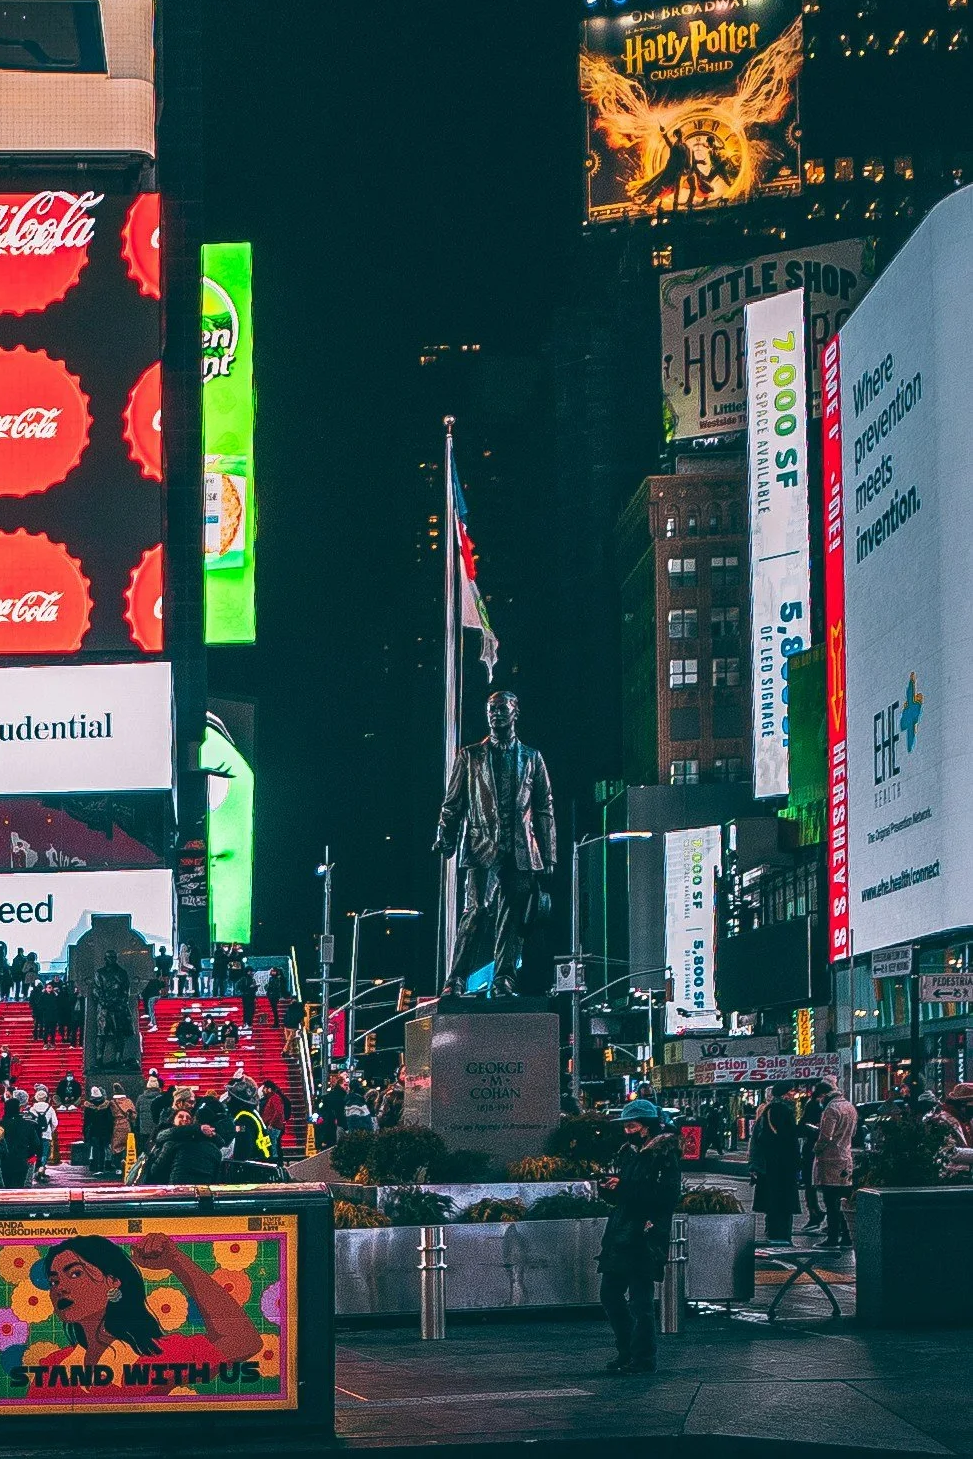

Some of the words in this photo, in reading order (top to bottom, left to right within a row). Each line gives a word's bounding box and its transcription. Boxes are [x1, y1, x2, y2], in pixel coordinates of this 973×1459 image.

[630, 9, 655, 25] ON
[621, 30, 690, 75] Harry
[689, 19, 761, 69] Potter
[650, 66, 694, 81] CURSED
[696, 60, 734, 75] CHILD
[683, 261, 779, 329] LITTLE
[784, 260, 857, 301] SHOP
[754, 340, 768, 388] RETAIL
[770, 330, 797, 437] 7,000
[852, 352, 894, 419] Where
[755, 392, 770, 435] SPACE
[854, 371, 923, 477] prevention
[757, 441, 771, 515] AVAILABLE
[775, 446, 798, 489] SF
[855, 454, 894, 515] meets
[856, 484, 922, 565] invention.
[760, 626, 773, 642] OF
[760, 648, 773, 673] LED
[761, 677, 775, 739] SIGNAGE
[873, 700, 901, 787] EHE
[832, 740, 847, 917] HERSHEY'S
[692, 890, 703, 910] SF
[692, 940, 704, 988] 5,800
[692, 991, 704, 1009] SF
[465, 1061, 524, 1075] GEORGE
[469, 1087, 522, 1100] COHAN
[10, 1365, 115, 1388] STAND
[123, 1362, 211, 1386] WITH
[219, 1361, 261, 1385] US
